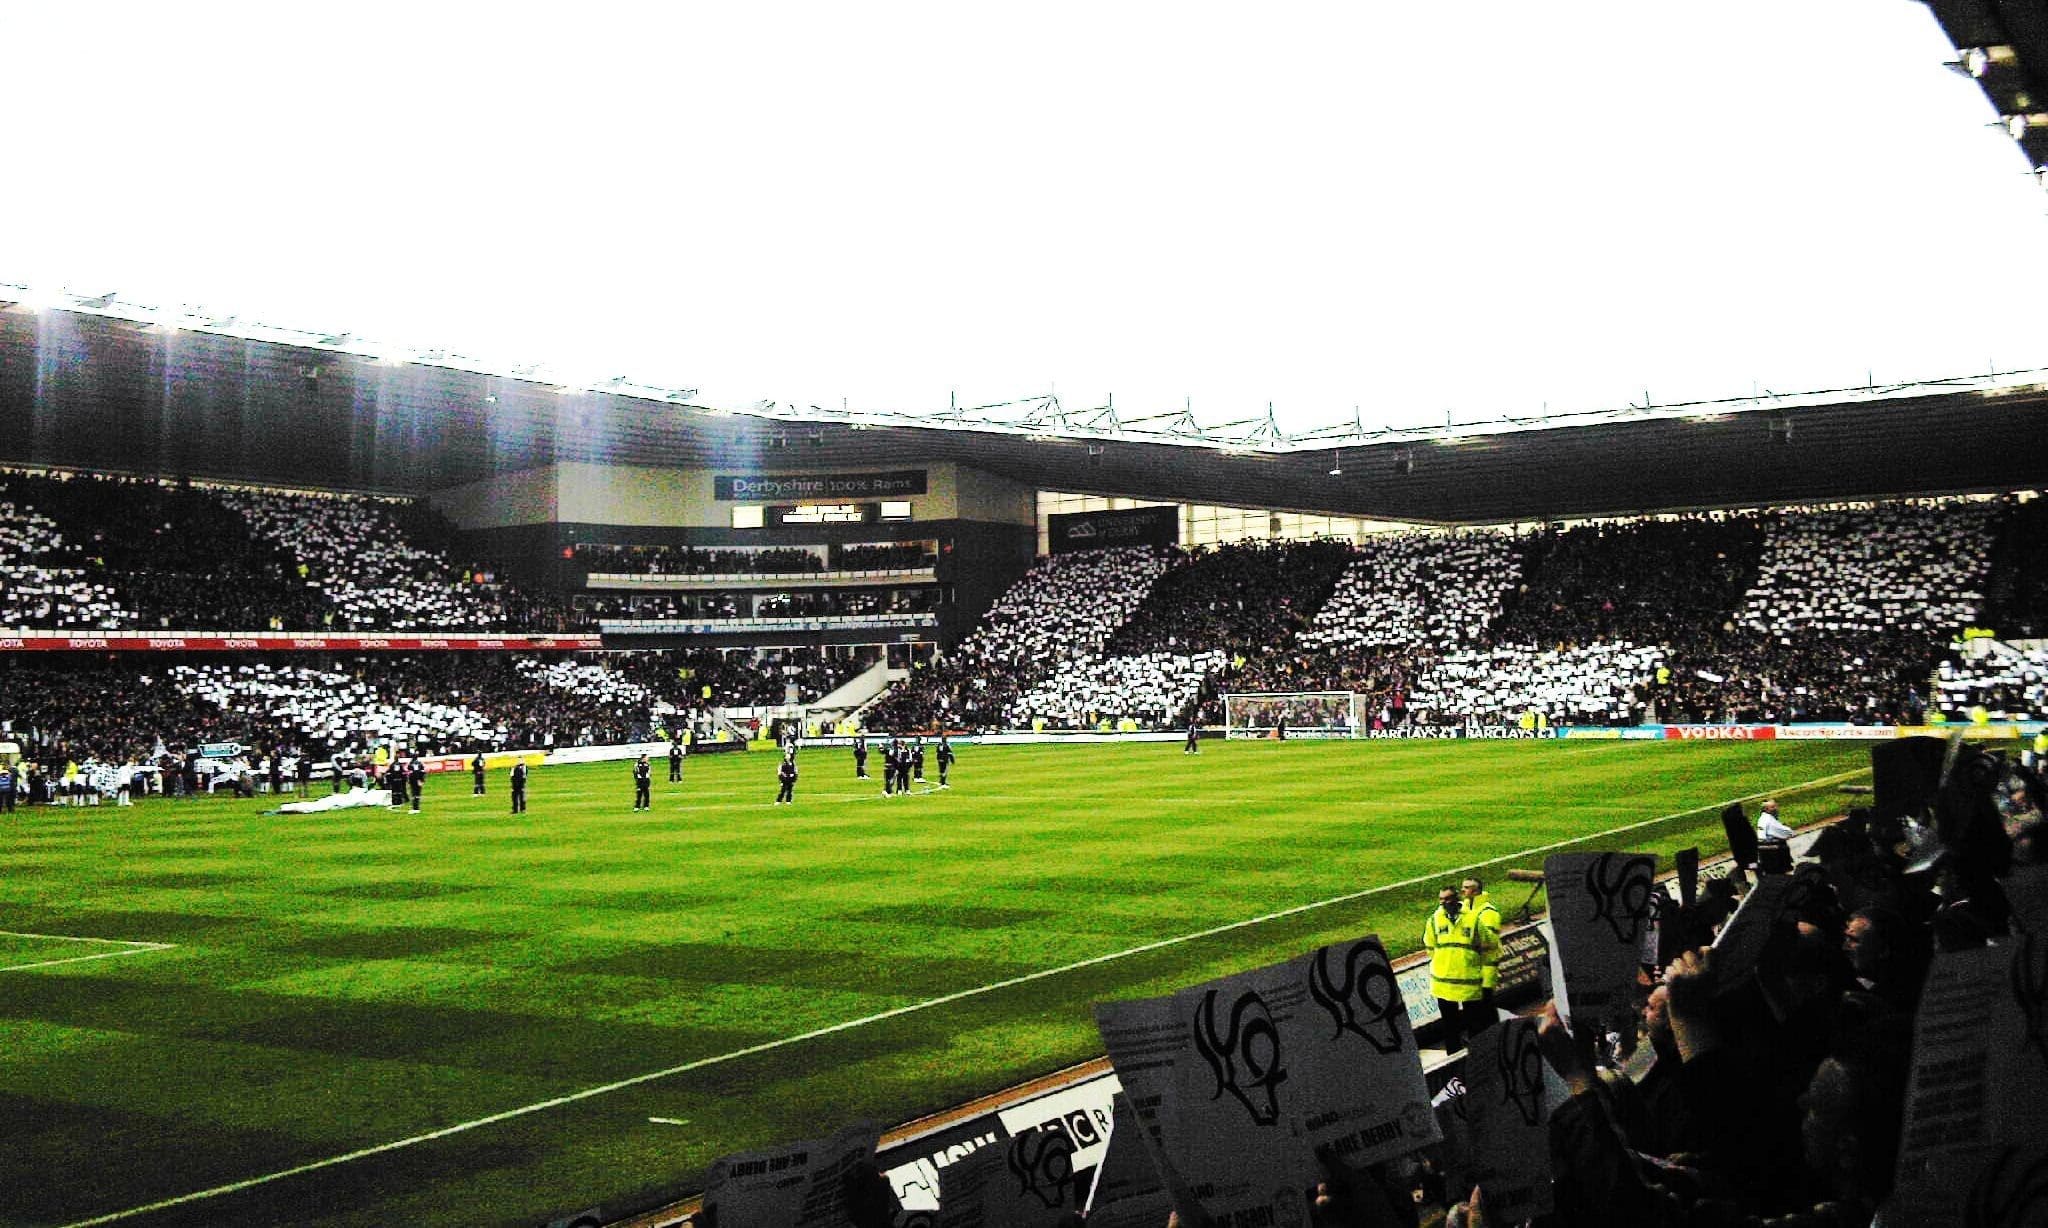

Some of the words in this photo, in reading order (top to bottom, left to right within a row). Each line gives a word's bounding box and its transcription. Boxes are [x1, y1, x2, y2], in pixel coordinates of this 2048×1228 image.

[733, 477, 824, 495] Derbyshire
[830, 480, 868, 491] 100%
[873, 478, 912, 490] Rams
[0, 639, 24, 648] YOTA
[69, 639, 108, 648] TOYOTA
[150, 639, 186, 648] TOYOTA
[224, 639, 259, 648] TOYOTA
[1369, 726, 1438, 739] BARCLAYS
[1465, 726, 1535, 739] BARCLAYS
[1678, 726, 1754, 739] VODKAT
[1360, 1119, 1403, 1148] DERBY
[728, 1160, 768, 1179] DERBY
